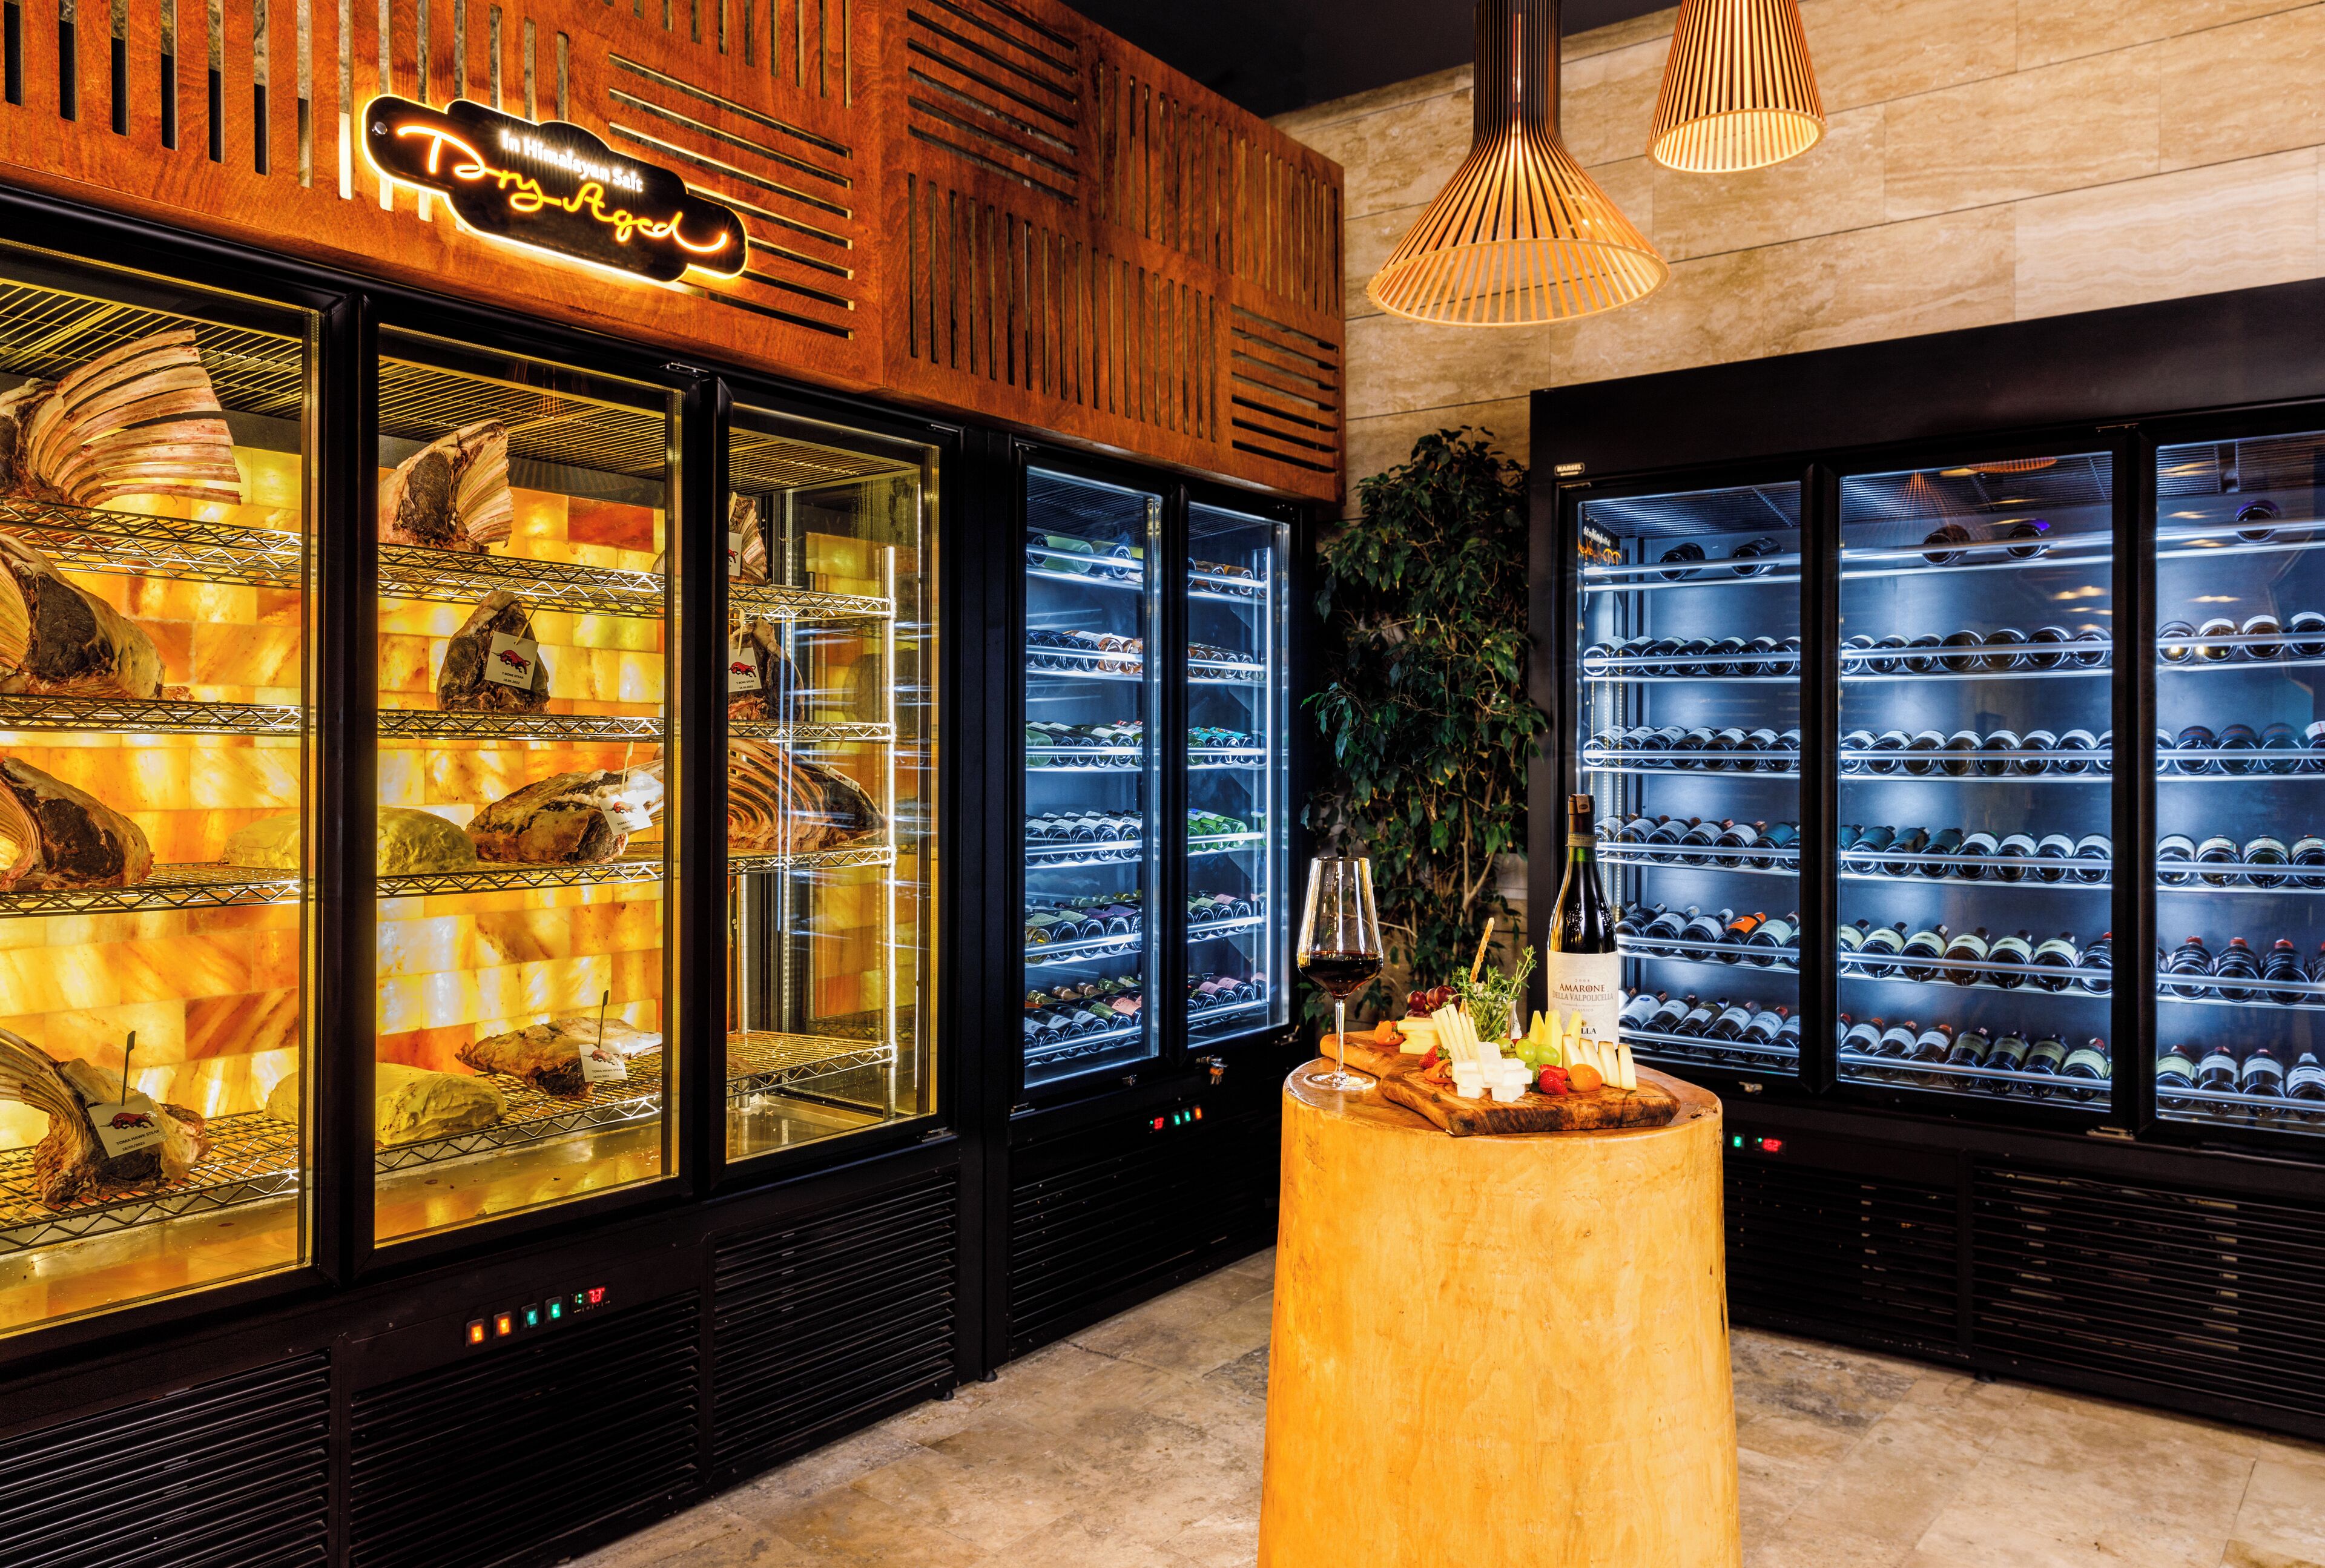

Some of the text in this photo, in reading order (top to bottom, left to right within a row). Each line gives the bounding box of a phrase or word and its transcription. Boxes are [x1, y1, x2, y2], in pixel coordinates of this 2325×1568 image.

[502, 130, 643, 193] In Himalayan Salt
[397, 125, 727, 253] Dry Aged
[1559, 983, 1606, 993] AMARONE
[1552, 990, 1614, 1003] DELLA VALPOLICELLA
[122, 1141, 145, 1151] 18/05/2022
